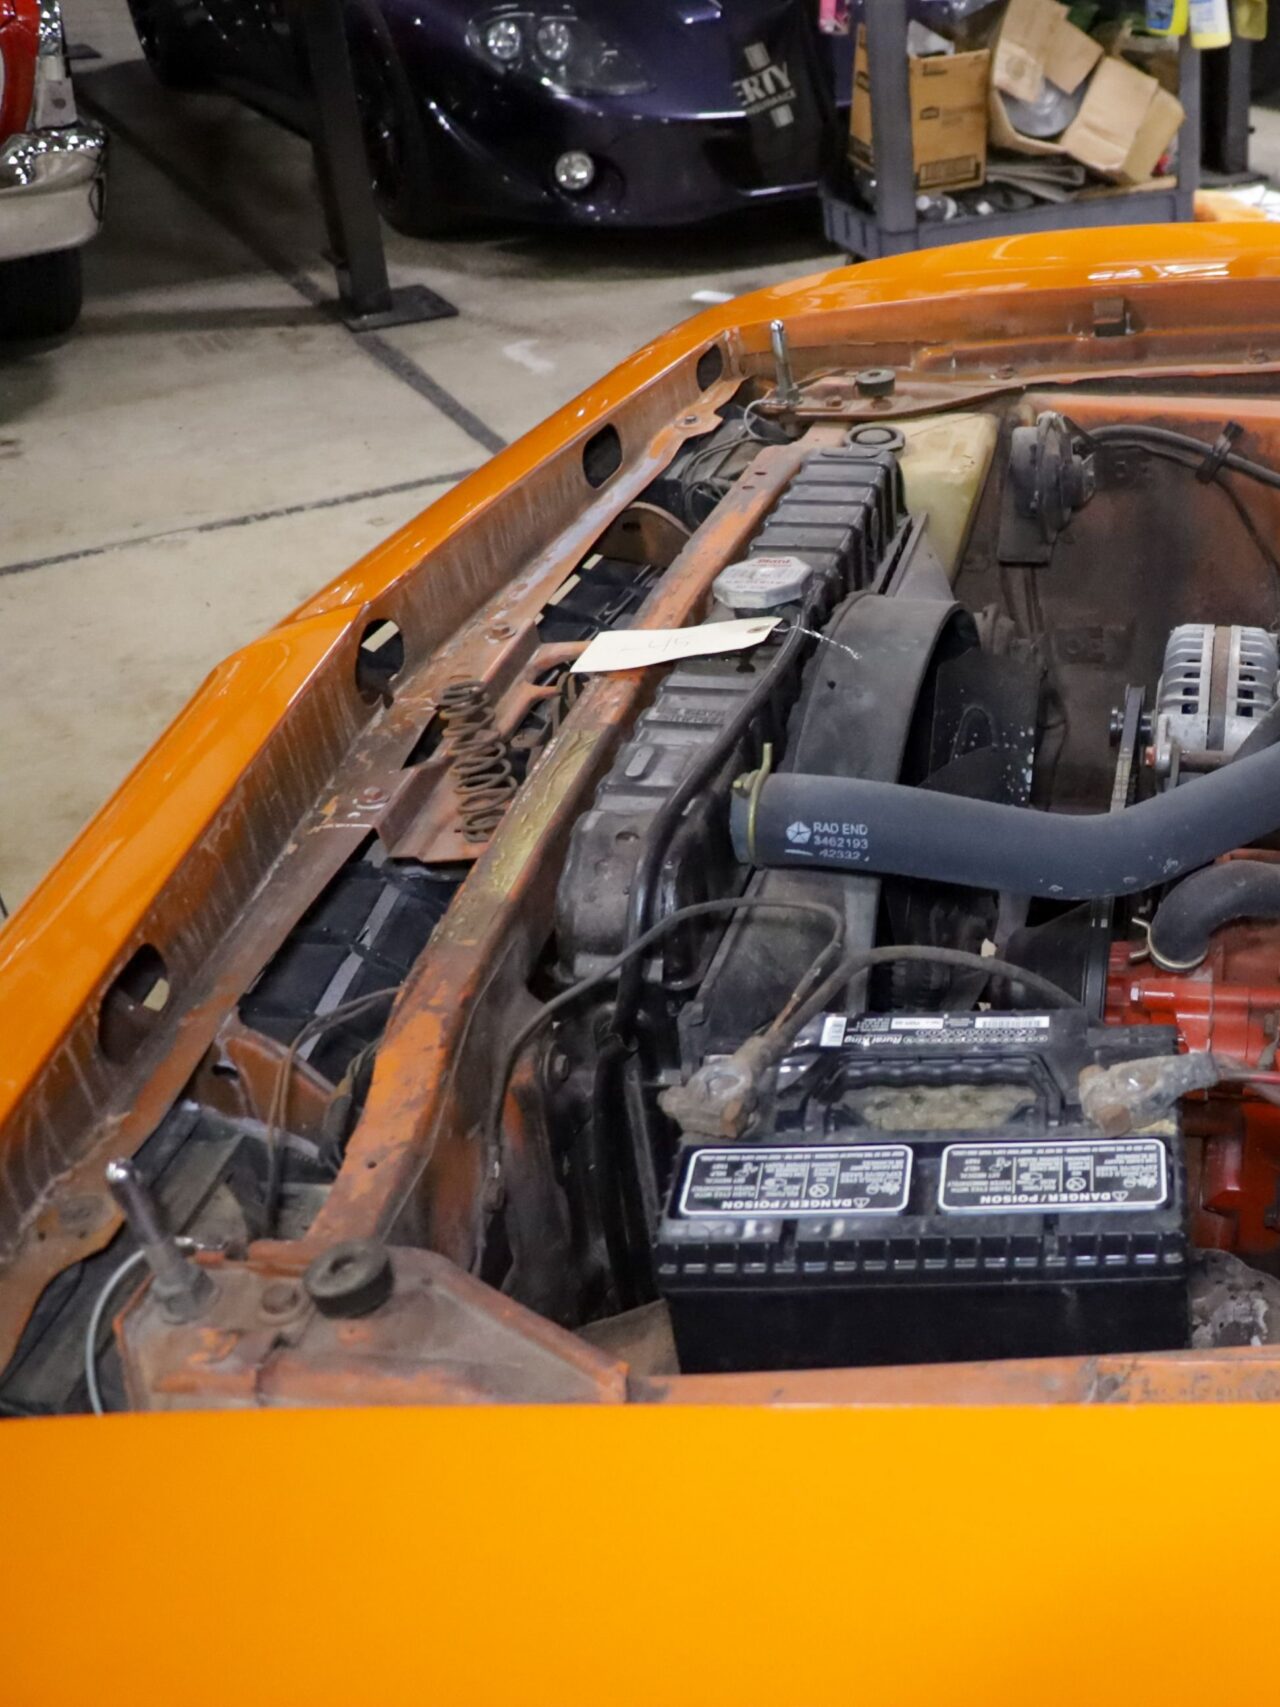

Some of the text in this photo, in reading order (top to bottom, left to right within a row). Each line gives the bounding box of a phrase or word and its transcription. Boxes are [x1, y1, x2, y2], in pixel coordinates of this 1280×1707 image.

[813, 821, 869, 836] RAD END
[813, 835, 870, 850] 3462193
[870, 1033, 902, 1045] Rural
